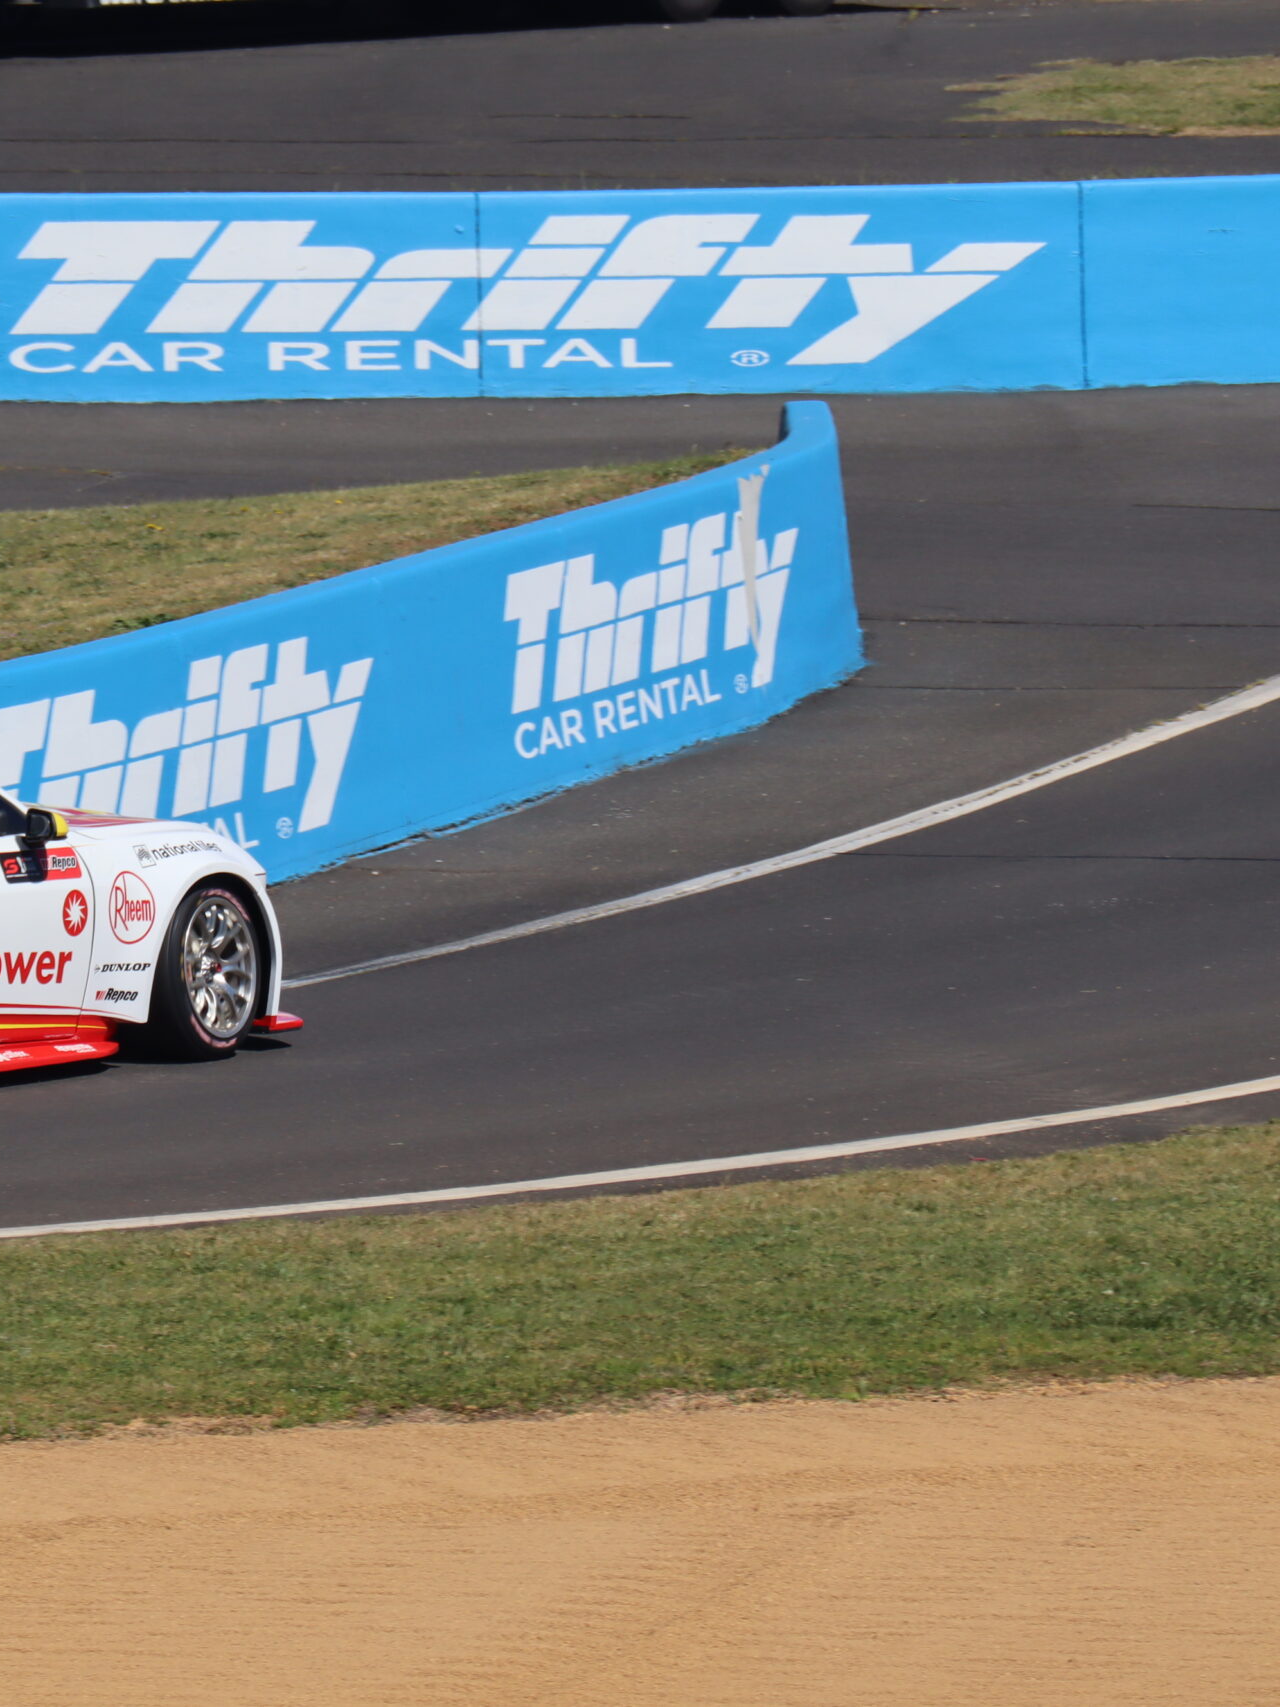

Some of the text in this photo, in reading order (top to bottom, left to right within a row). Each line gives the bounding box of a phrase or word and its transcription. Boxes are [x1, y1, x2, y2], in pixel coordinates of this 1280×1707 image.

[8, 213, 1048, 366] Thrifty
[9, 341, 224, 373] CAR
[267, 337, 674, 371] RENTAL
[503, 510, 799, 716] Thrifty
[514, 668, 722, 759] CAR RENTAL
[51, 855, 76, 873] Repco
[152, 840, 200, 861] national
[114, 875, 152, 931] Rheem
[101, 963, 151, 973] DUNLOP
[104, 987, 139, 1003] Repco
